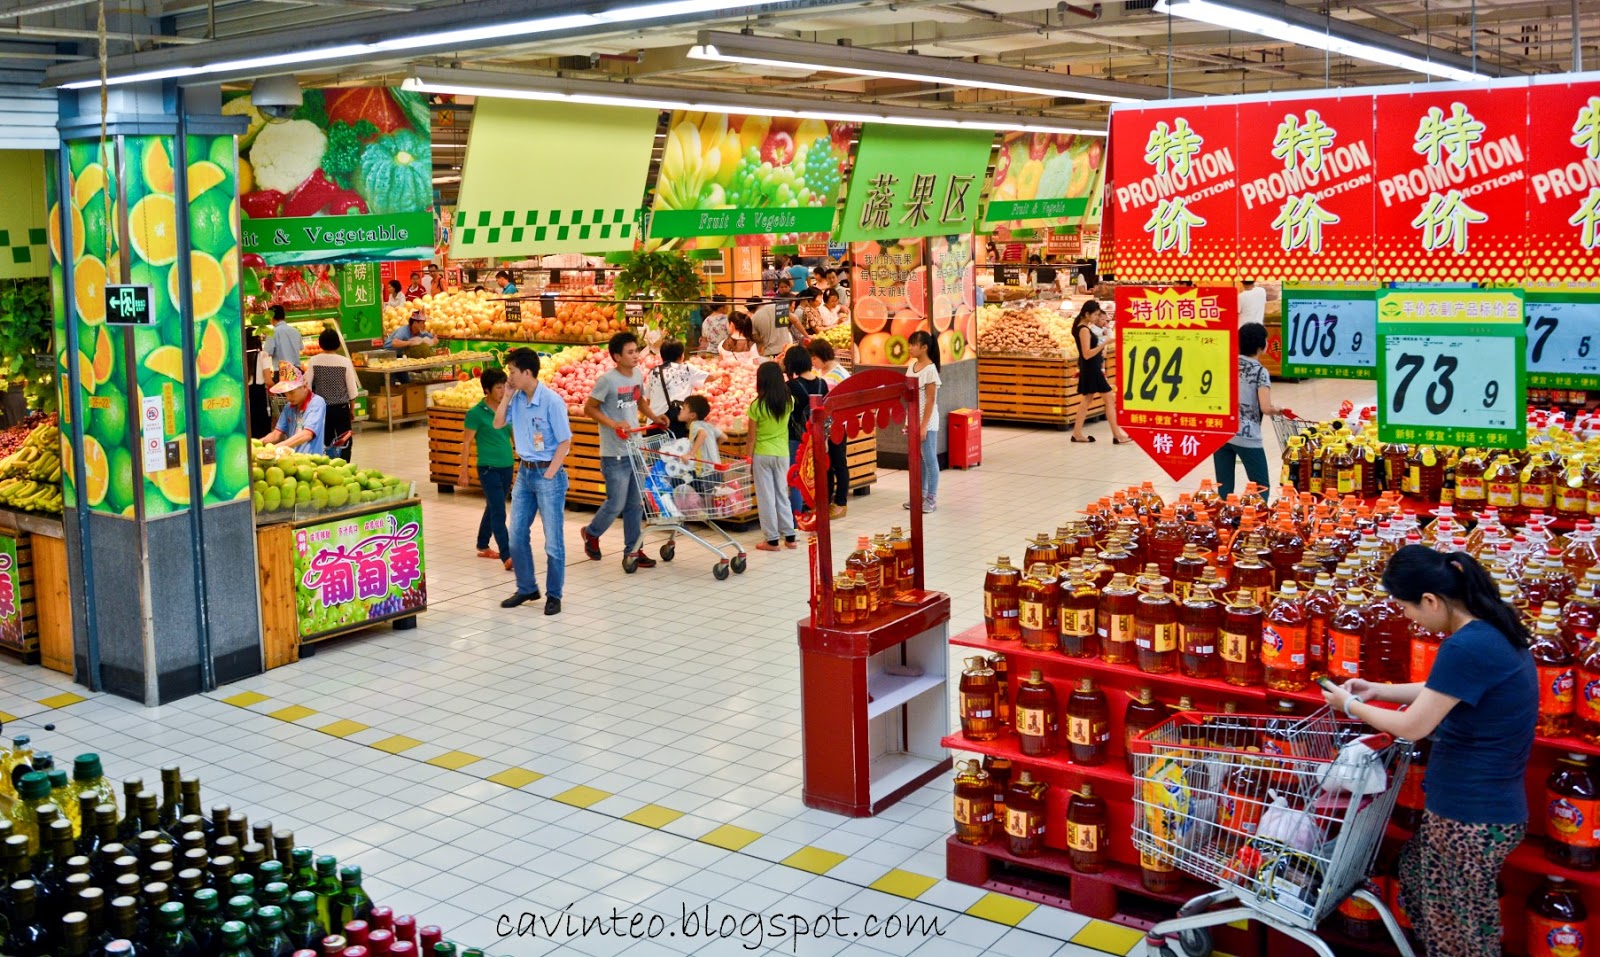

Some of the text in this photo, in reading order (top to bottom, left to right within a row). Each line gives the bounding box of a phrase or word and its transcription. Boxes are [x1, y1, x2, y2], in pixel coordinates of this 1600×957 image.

[1116, 147, 1236, 213] PROMOTION
[1240, 140, 1372, 210] PROMOTION
[1378, 134, 1525, 208] PROMOTION
[699, 211, 796, 232] Fruit & Vegeble
[860, 173, 976, 231] 蔬果区
[273, 229, 291, 246] &
[303, 225, 409, 246] Vegetable
[1131, 298, 1220, 321] 特价商品
[207, 397, 231, 409] 2F-23
[1153, 433, 1201, 456] 特价
[303, 540, 421, 607] 葡萄季
